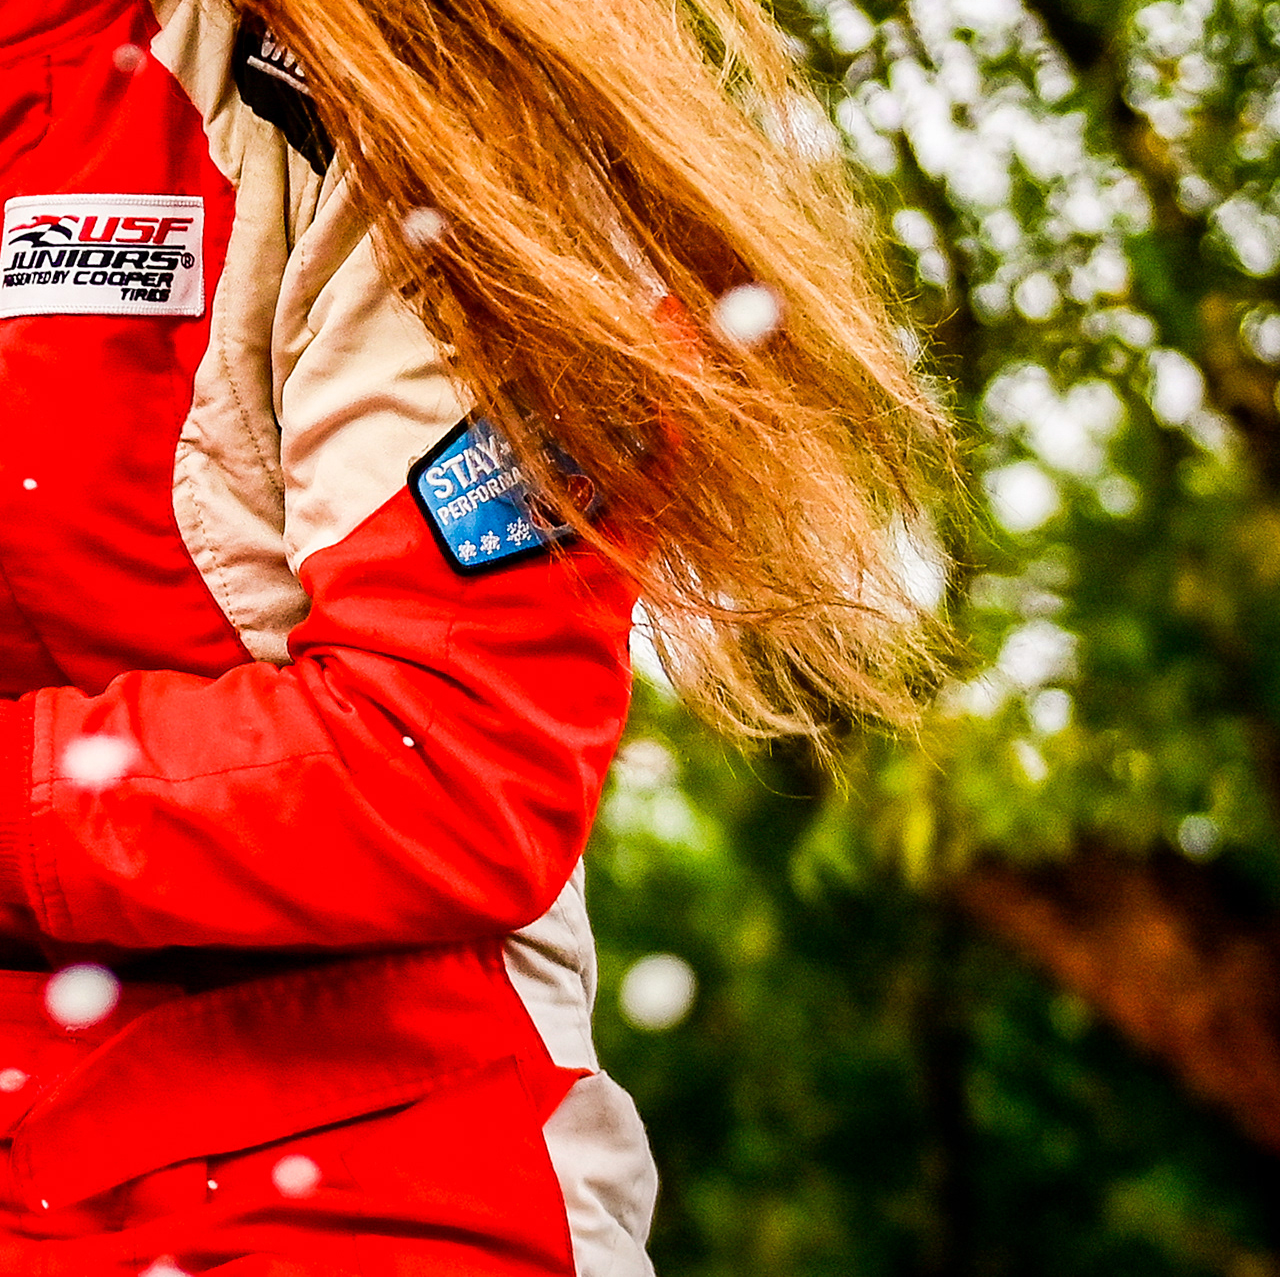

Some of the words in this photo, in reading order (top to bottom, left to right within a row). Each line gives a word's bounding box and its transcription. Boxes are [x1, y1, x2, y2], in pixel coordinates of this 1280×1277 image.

[78, 216, 194, 244] USF
[2, 271, 51, 289] PRESENTED
[51, 270, 70, 284] BY
[73, 271, 174, 288] COOPER
[121, 288, 171, 302] TIRES
[425, 435, 502, 499] STAY
[437, 466, 523, 526] PERFORMA
